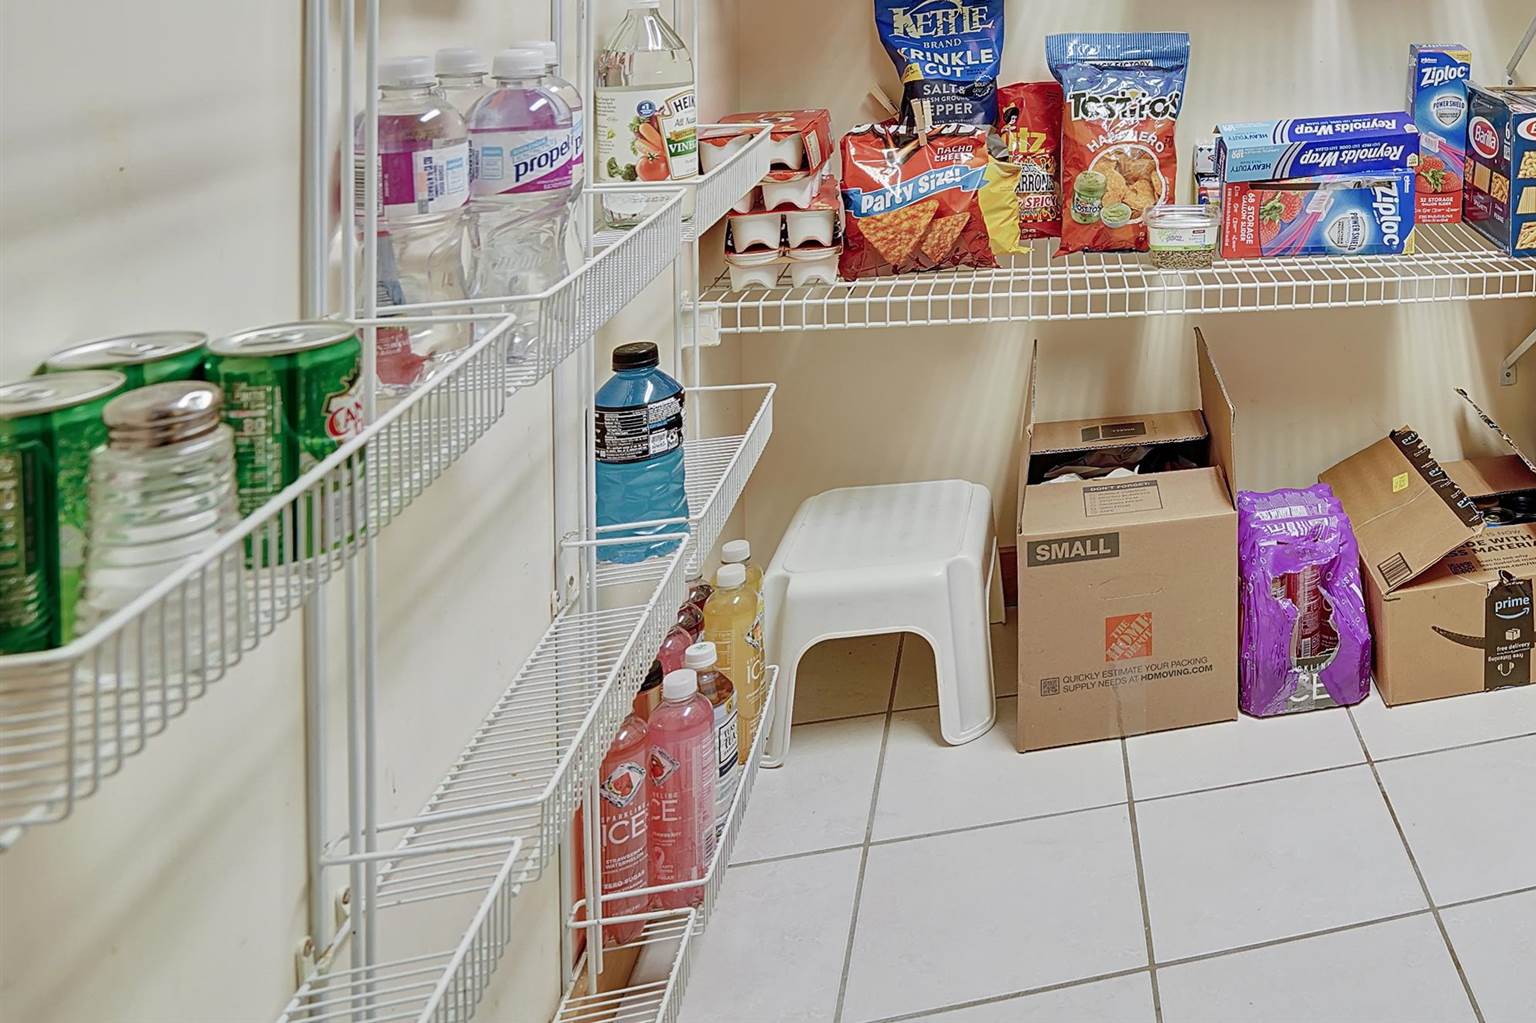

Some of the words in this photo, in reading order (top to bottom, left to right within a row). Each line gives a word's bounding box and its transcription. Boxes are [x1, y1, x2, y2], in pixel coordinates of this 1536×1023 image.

[923, 38, 962, 49] BRAND
[924, 62, 965, 78] CUT
[1420, 64, 1468, 87] Ziploc
[923, 83, 956, 95] SALT
[931, 103, 973, 116] EPPER
[1294, 123, 1334, 136] Wrap
[1334, 118, 1397, 134] Reynolds
[1473, 123, 1498, 151] Barilla
[514, 134, 573, 182] propel
[936, 144, 974, 155] NACHO
[1299, 150, 1338, 167] Wrap
[1338, 144, 1405, 164] Reynolds
[1247, 162, 1272, 172] HEAVY
[861, 183, 914, 213] Party
[918, 168, 963, 192] Size!
[1024, 195, 1058, 207] SPICY
[1372, 180, 1402, 247] Ziploc
[1246, 205, 1255, 245] STORAGE
[1036, 537, 1112, 562] SMALL
[1490, 533, 1533, 546] WITH
[1495, 596, 1531, 612] prime
[1105, 612, 1152, 662] HOME
[1111, 620, 1130, 640] THE
[1122, 628, 1152, 660] DEPOT
[1496, 644, 1508, 653] free
[1508, 641, 1531, 651] delivery
[1062, 671, 1101, 685] QUICKLY
[1101, 665, 1144, 678] ESTIMATE
[1144, 661, 1170, 672] YOUR
[1170, 656, 1209, 669] PACKING
[1062, 680, 1098, 694] SUPPLY
[1098, 677, 1129, 688] NEEDS
[1129, 675, 1140, 684] AT
[1140, 664, 1214, 682] HDMOVING.COM
[601, 814, 648, 849] ICE
